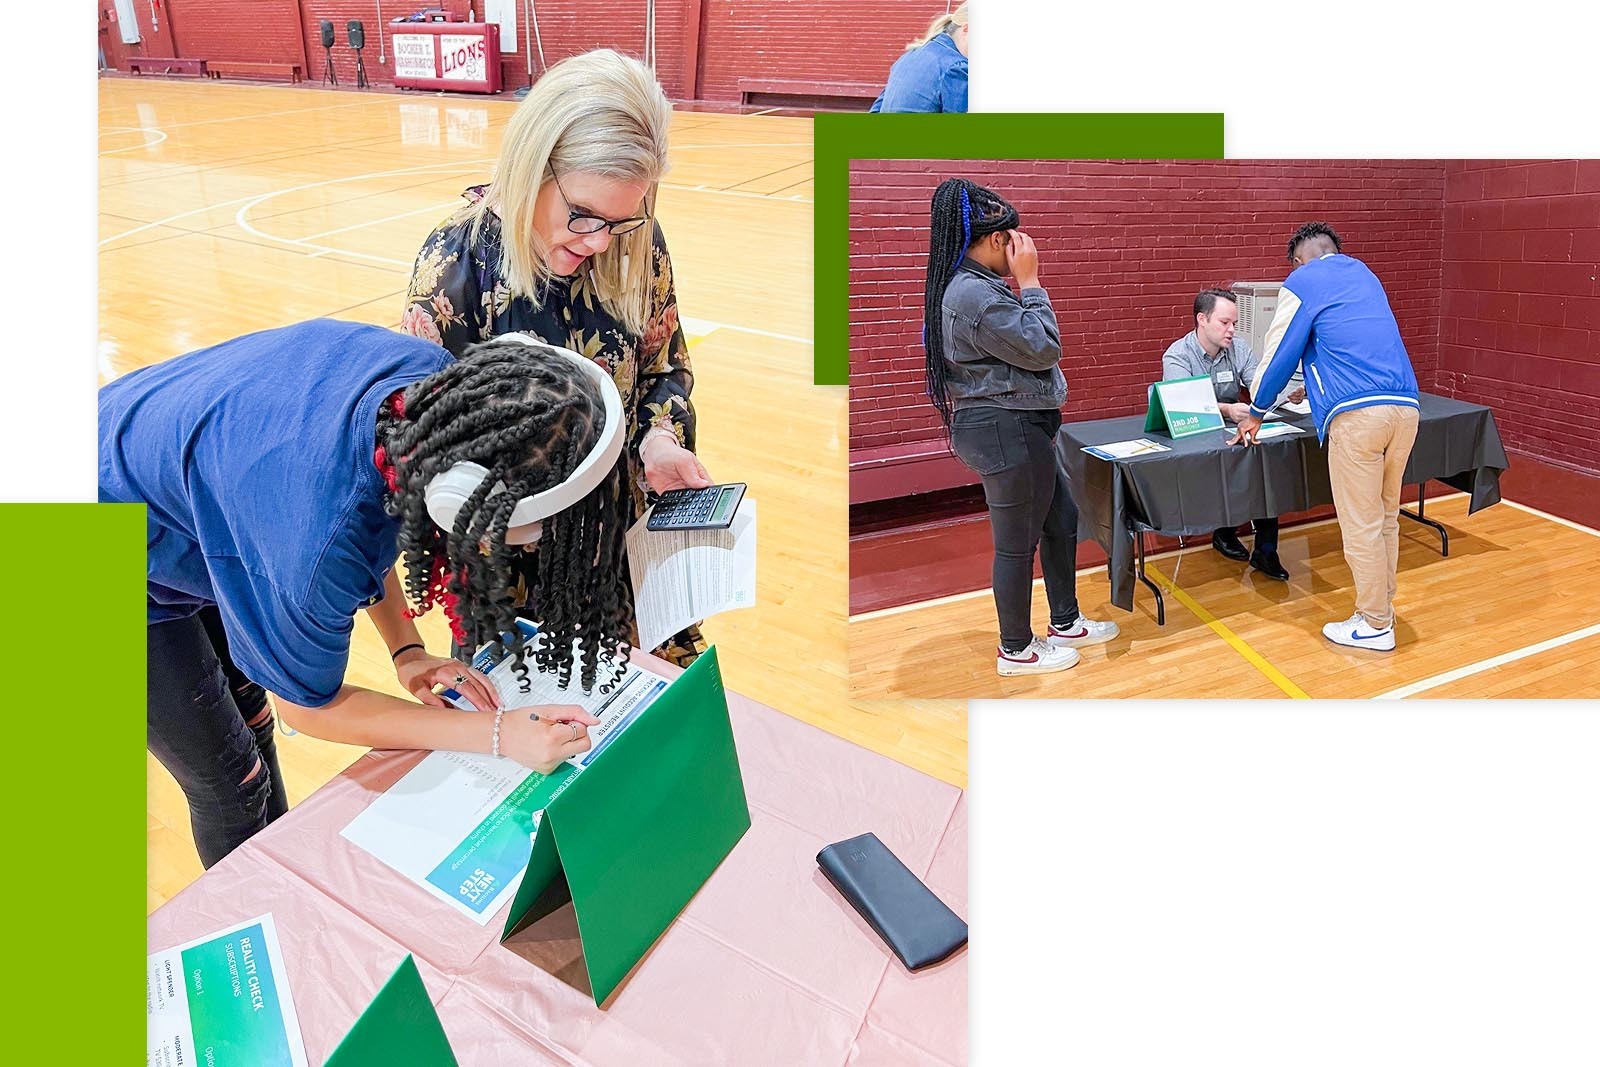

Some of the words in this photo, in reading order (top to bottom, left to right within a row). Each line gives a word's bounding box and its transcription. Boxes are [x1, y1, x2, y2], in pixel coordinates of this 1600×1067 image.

[444, 40, 485, 72] LIONS
[1172, 418, 1186, 428] 2ND
[1186, 416, 1198, 425] JOB
[635, 676, 657, 698] CHECKING
[617, 695, 638, 716] ACCOUNT
[597, 714, 620, 737] REGISTER
[457, 867, 486, 896] STEP
[466, 873, 496, 903] NEXT
[193, 968, 202, 990] Option
[224, 943, 242, 997] SUBSCRIPTIONS
[239, 937, 256, 975] REALITY
[248, 976, 264, 1012] CHECK
[174, 1035, 183, 1066] MODERATE
[204, 1046, 214, 1067] Optio
